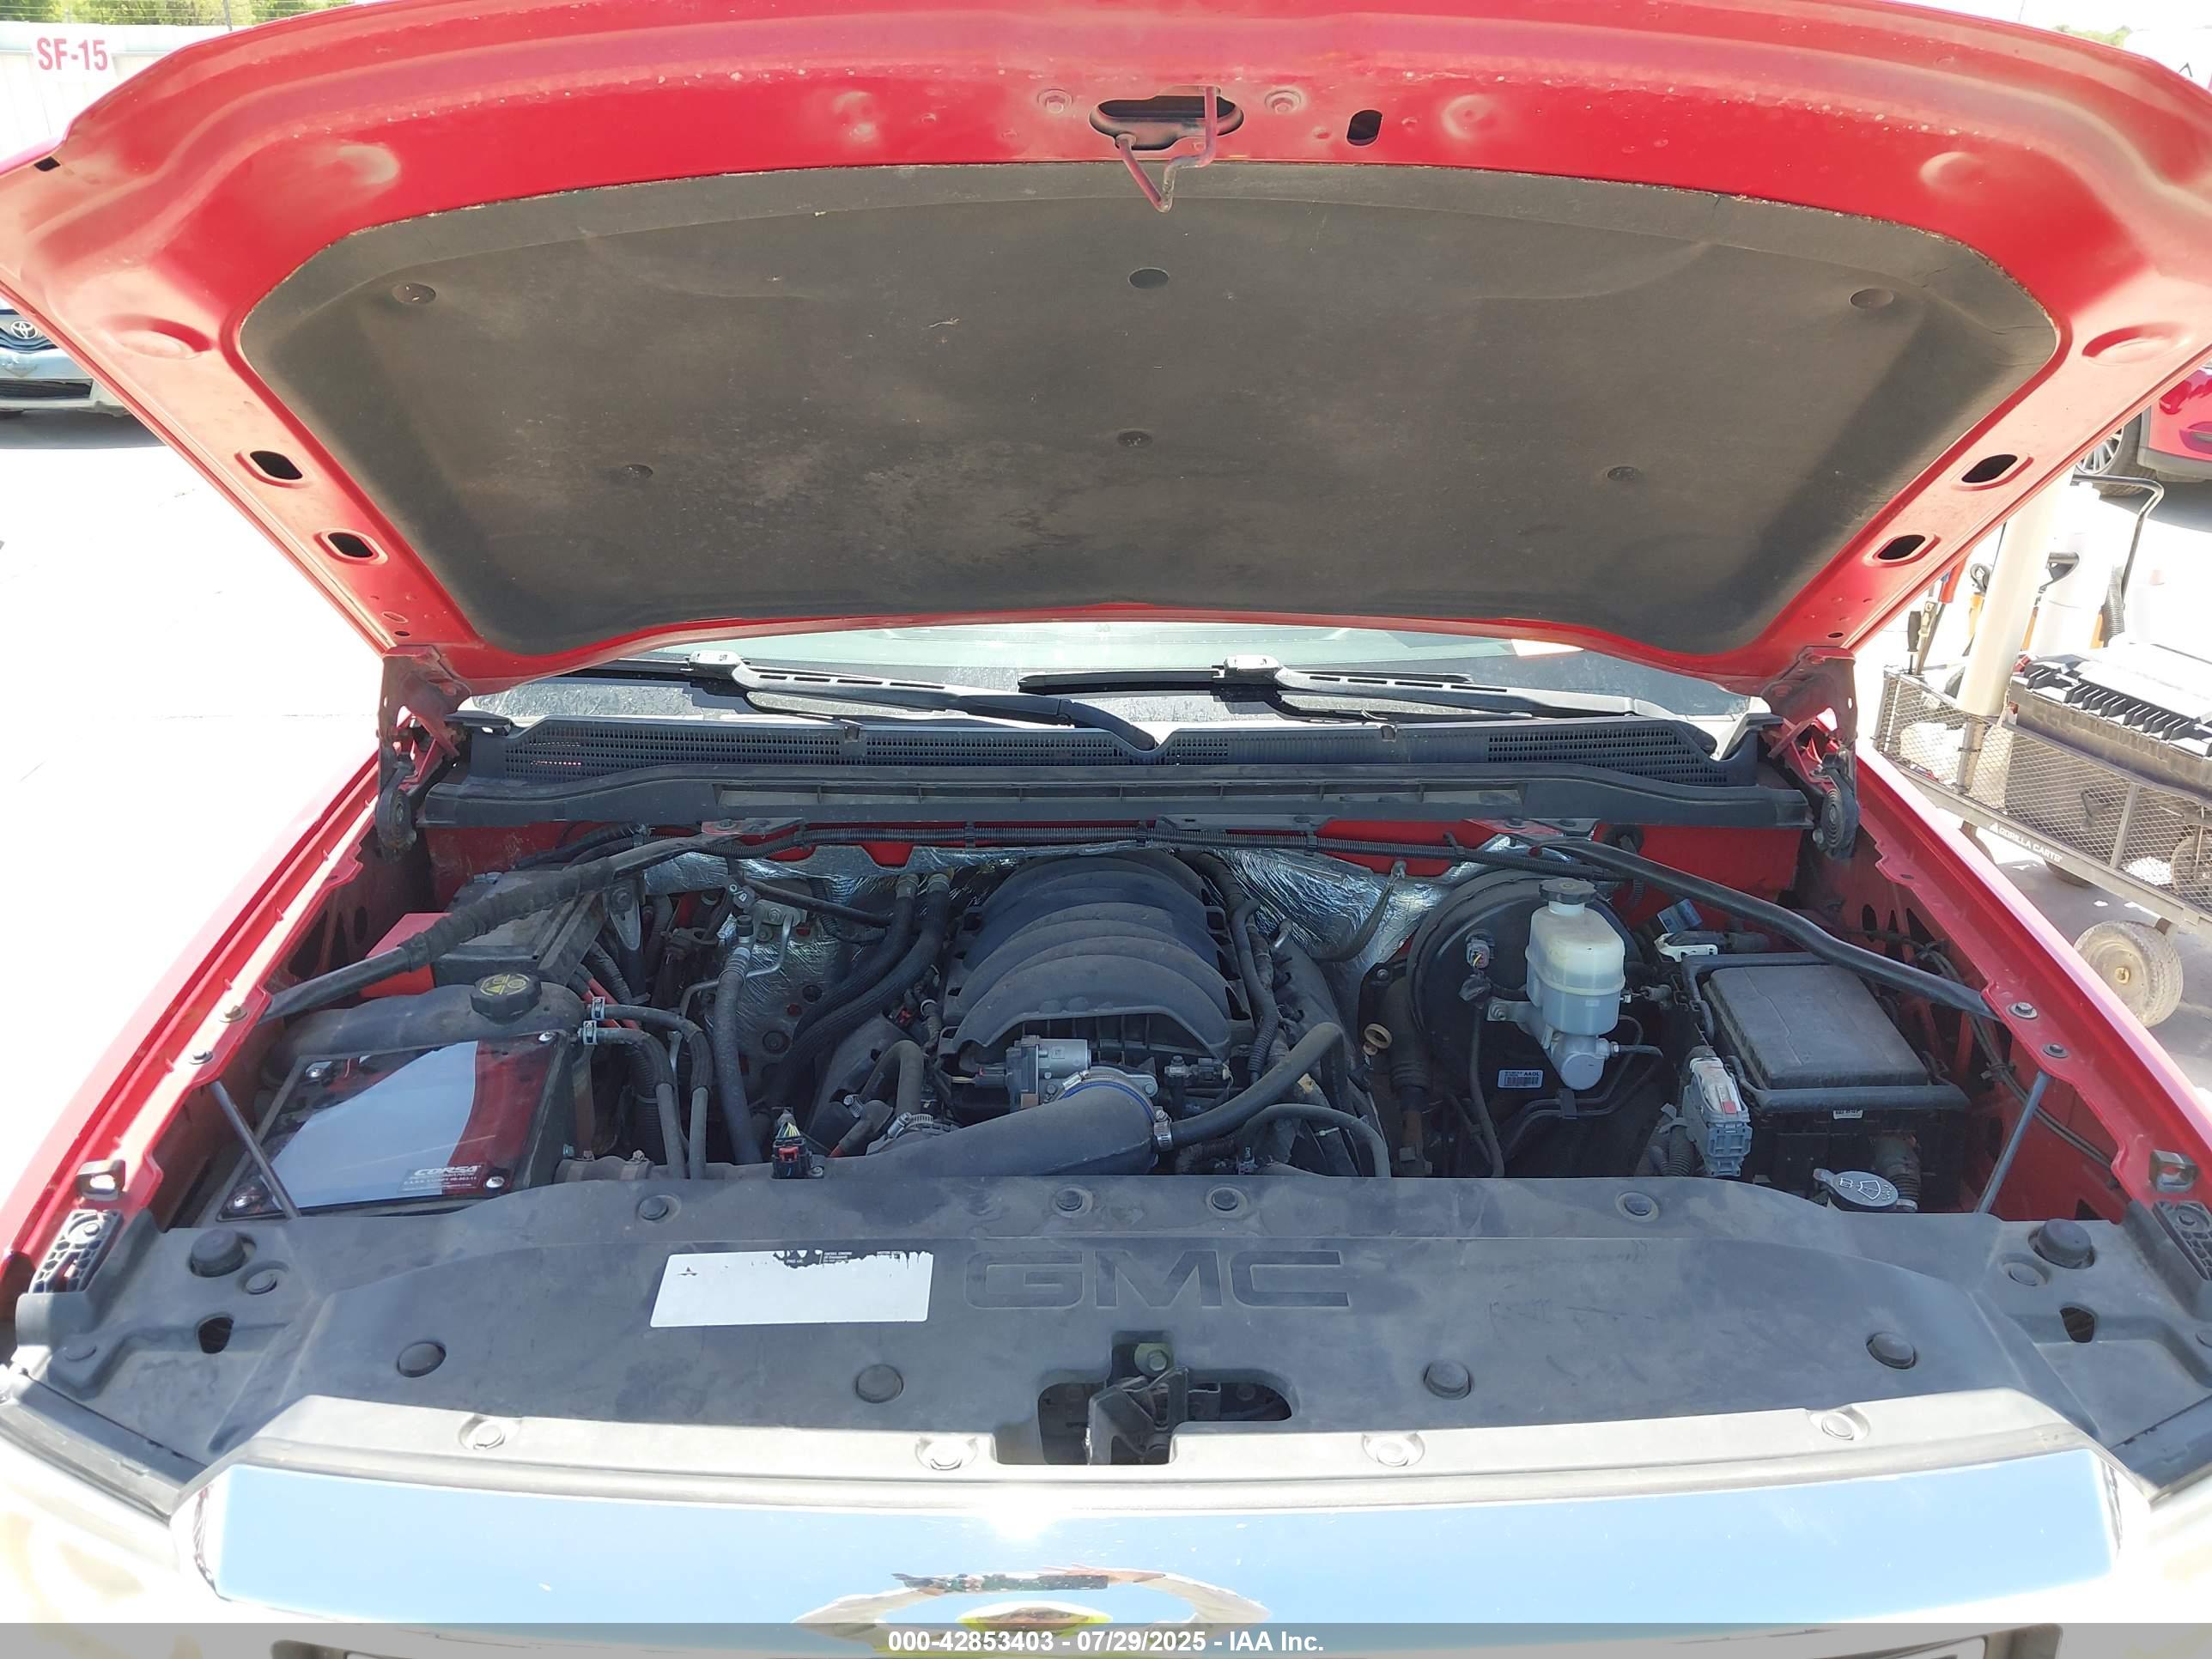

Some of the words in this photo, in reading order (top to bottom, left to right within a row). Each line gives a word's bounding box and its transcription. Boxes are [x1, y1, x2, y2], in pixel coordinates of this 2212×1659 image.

[37, 37, 107, 70] SF-15
[414, 1165, 479, 1176] CORSA
[965, 1249, 1351, 1310] GMC
